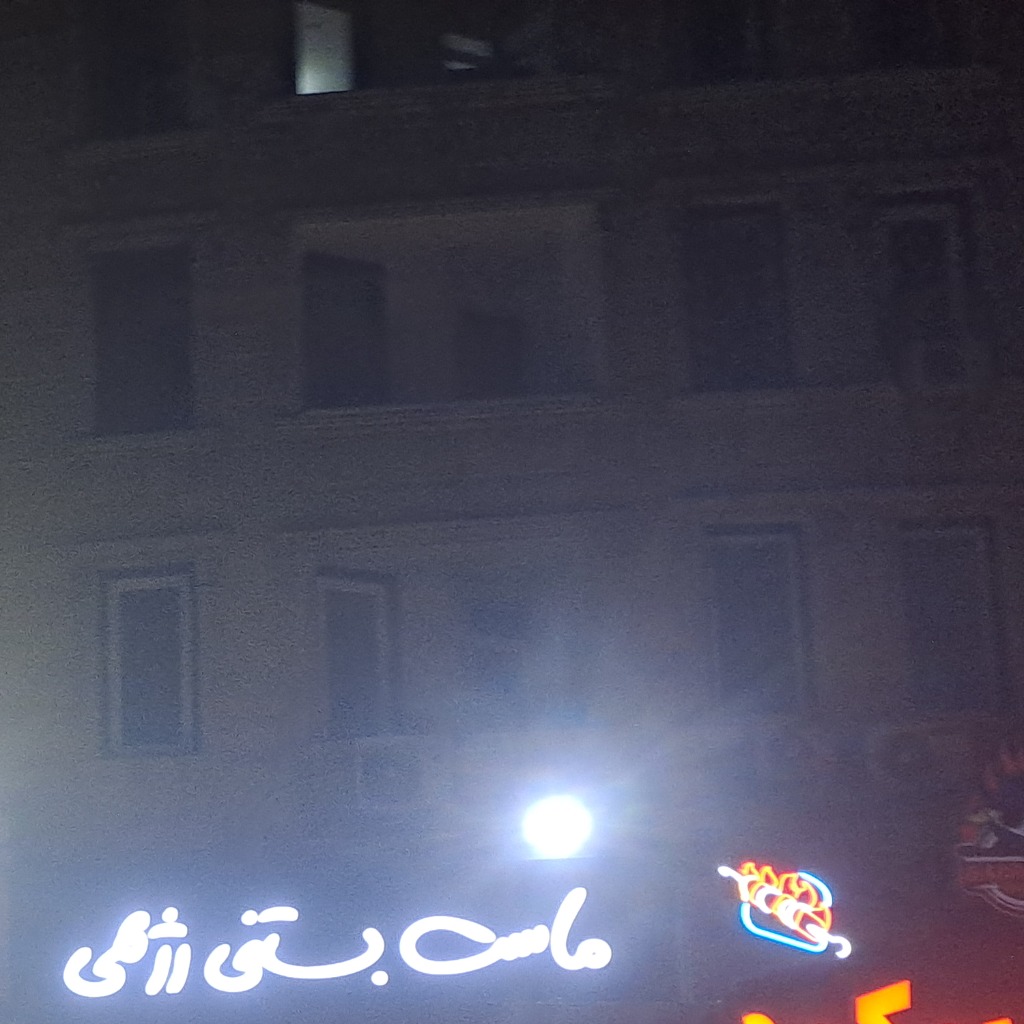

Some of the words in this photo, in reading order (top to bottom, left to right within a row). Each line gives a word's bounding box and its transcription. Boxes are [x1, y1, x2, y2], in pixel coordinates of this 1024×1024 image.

[62, 905, 191, 997] رژیمی
[203, 905, 389, 992] بستنی
[399, 886, 612, 974] ماست
